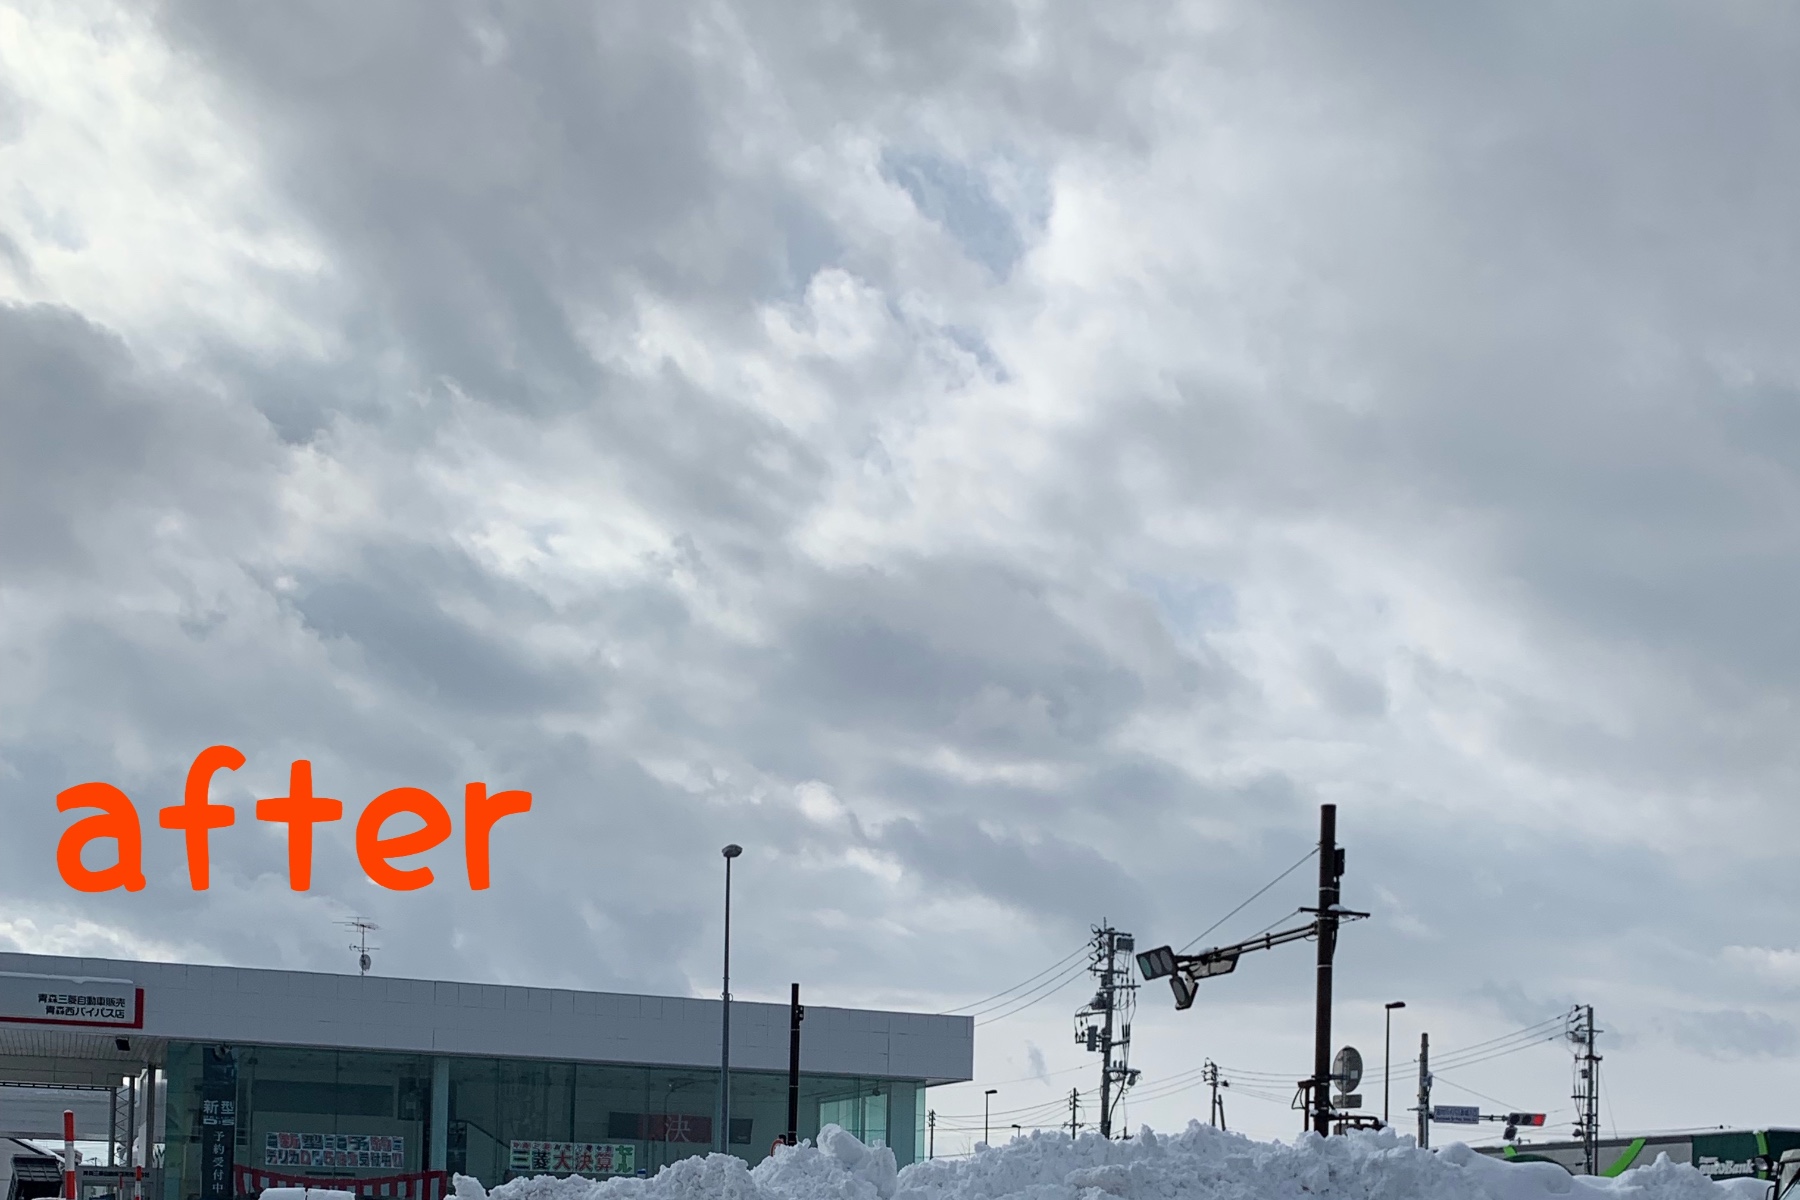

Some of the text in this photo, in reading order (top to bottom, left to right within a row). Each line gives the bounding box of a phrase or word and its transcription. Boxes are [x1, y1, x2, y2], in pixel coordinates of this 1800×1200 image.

[38, 993, 126, 1007] 青森三菱自動車販売
[45, 1005, 125, 1019] 青森西バイパス店
[203, 1099, 235, 1115] 新型
[665, 1114, 690, 1141] 決
[211, 1131, 225, 1194] 予約受付中
